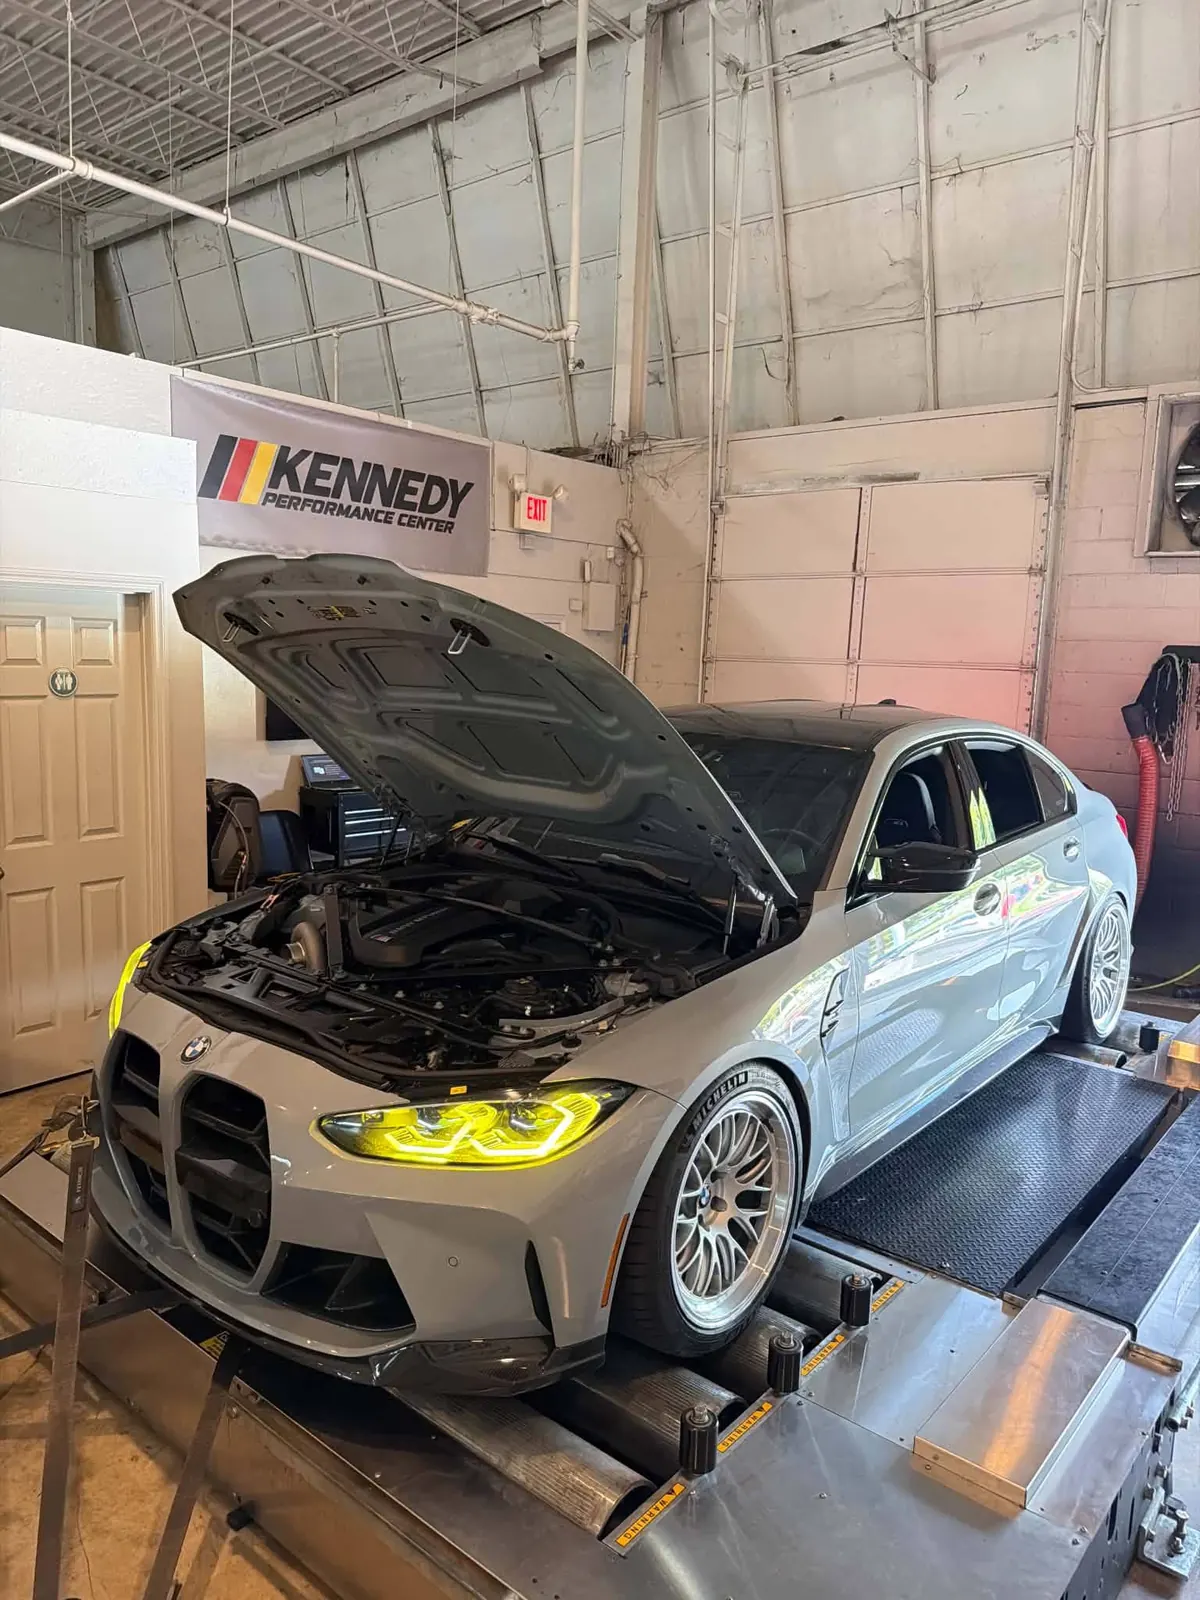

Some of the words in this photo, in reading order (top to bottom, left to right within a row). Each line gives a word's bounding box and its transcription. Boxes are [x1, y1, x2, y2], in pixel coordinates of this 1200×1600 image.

[268, 445, 475, 519] KENNEDY
[261, 492, 395, 525] PERFORMANCE
[397, 513, 455, 534] CENTER
[527, 496, 547, 521] EXIT
[690, 1071, 748, 1132] MICHELIN
[722, 1415, 757, 1446] WARNING
[623, 1499, 666, 1539] WARNING
